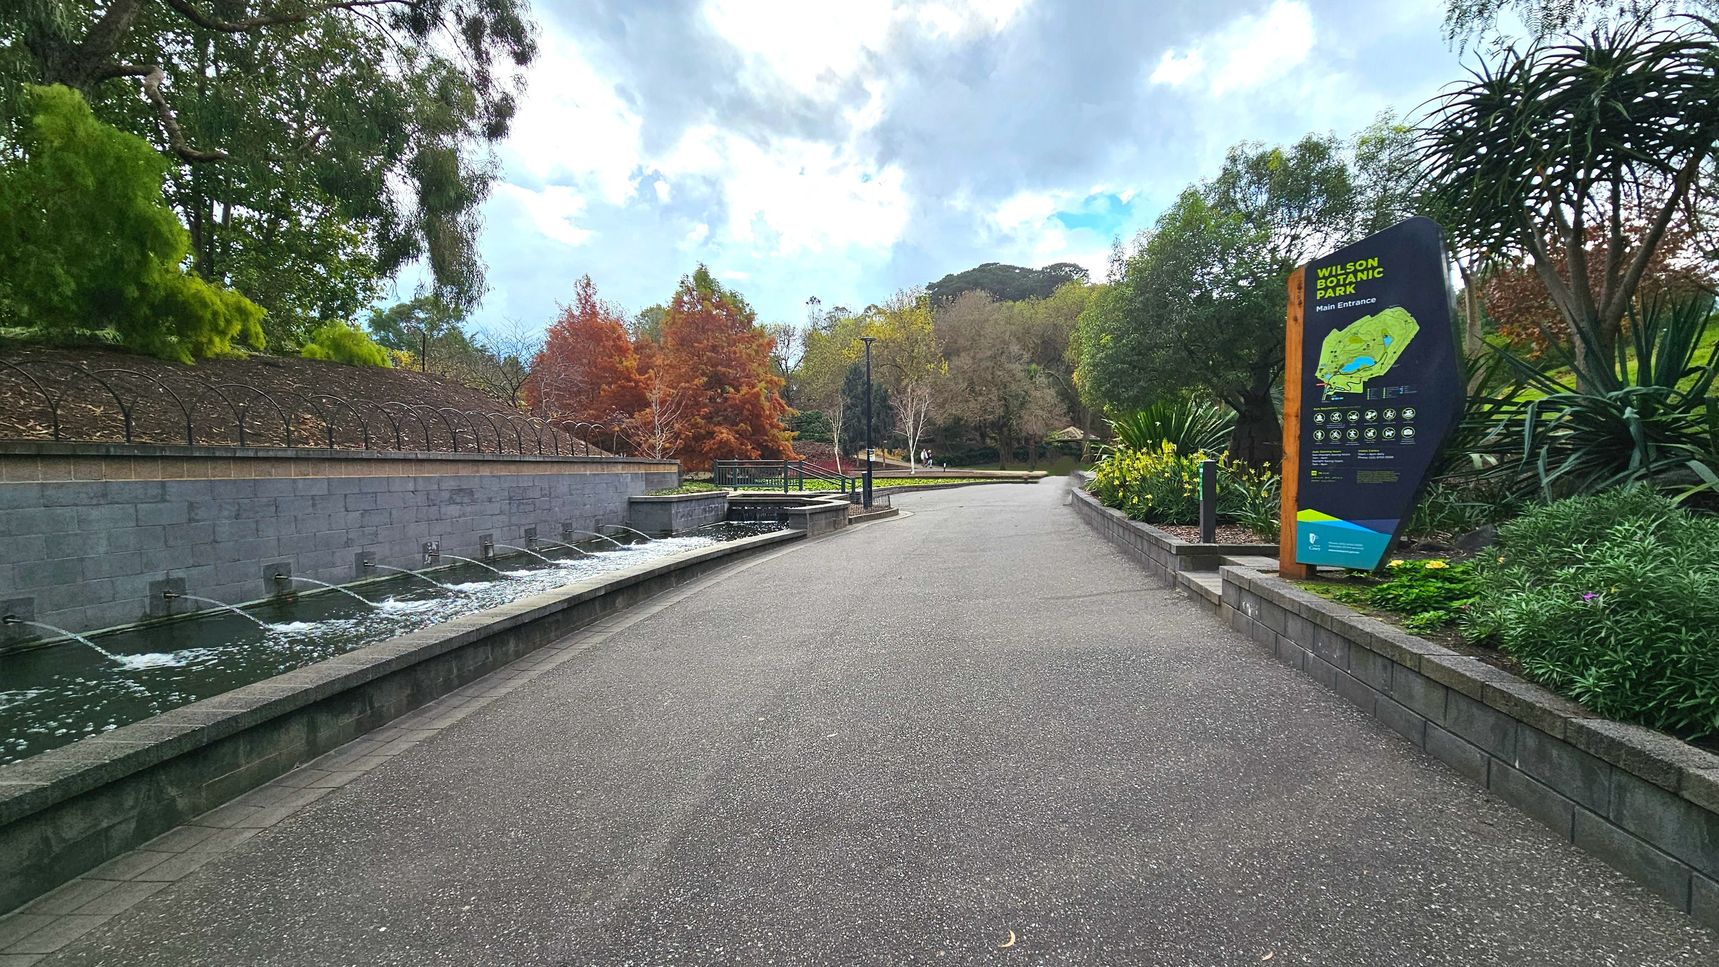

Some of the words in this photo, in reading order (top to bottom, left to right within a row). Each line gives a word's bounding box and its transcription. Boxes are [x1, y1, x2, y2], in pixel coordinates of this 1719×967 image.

[1317, 257, 1379, 278] WILSON
[1316, 268, 1384, 289] BOTANIC
[1316, 284, 1356, 299] PARK
[1316, 304, 1335, 312] Main
[1337, 297, 1377, 309] Entrance
